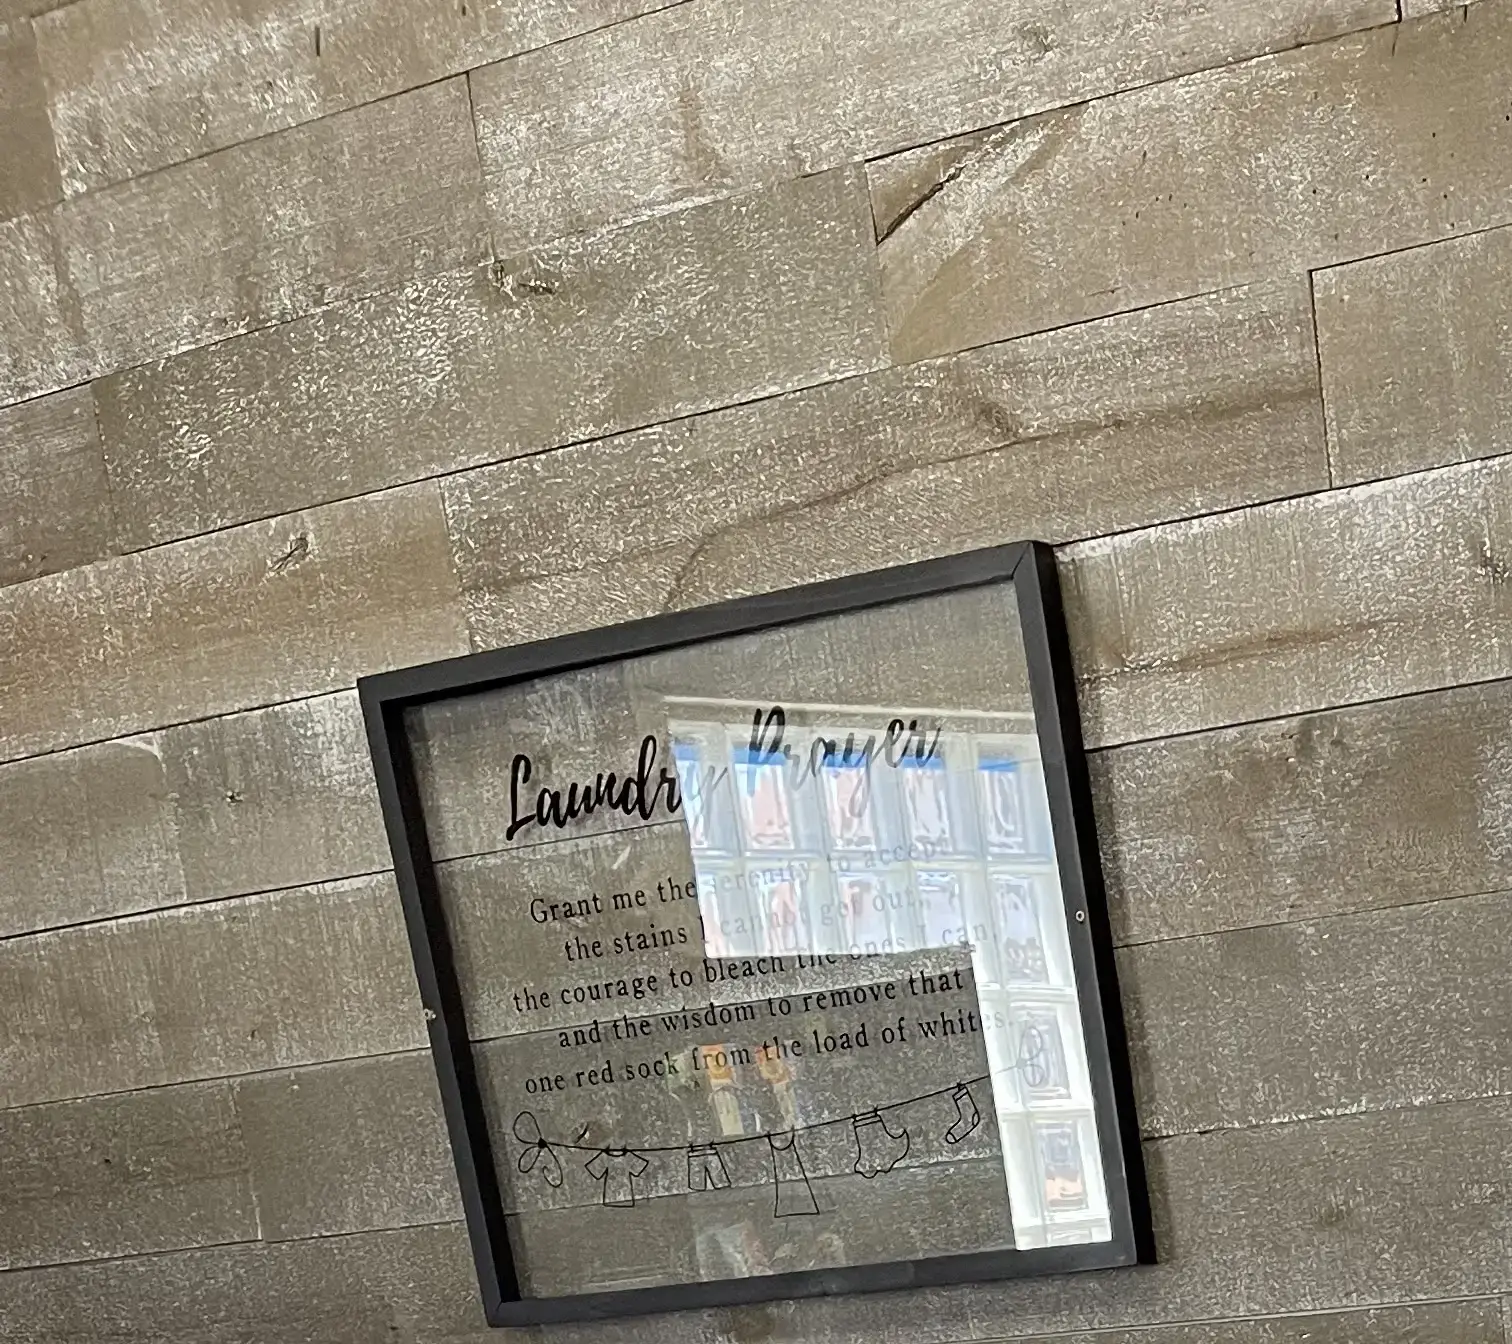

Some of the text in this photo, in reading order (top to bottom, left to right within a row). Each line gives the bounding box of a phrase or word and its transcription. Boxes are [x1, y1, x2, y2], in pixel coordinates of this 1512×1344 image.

[506, 706, 941, 845] Laundry Prayer
[530, 893, 604, 924] Grant
[612, 889, 647, 910] me
[657, 877, 698, 902] the
[826, 853, 850, 873] to
[513, 988, 550, 1012] the
[561, 975, 658, 1004] courage
[668, 967, 693, 988] to
[703, 954, 785, 983] bleach
[796, 944, 837, 968] the
[564, 937, 603, 962] the
[613, 923, 688, 954] stains
[559, 967, 964, 1047] and the wisdom to remove that
[525, 1073, 566, 1094] one
[575, 1060, 615, 1088] red
[625, 1051, 680, 1080] sock
[692, 1046, 750, 1071] from
[762, 1036, 801, 1061] the
[812, 1022, 869, 1054] load
[881, 1017, 907, 1043] of
